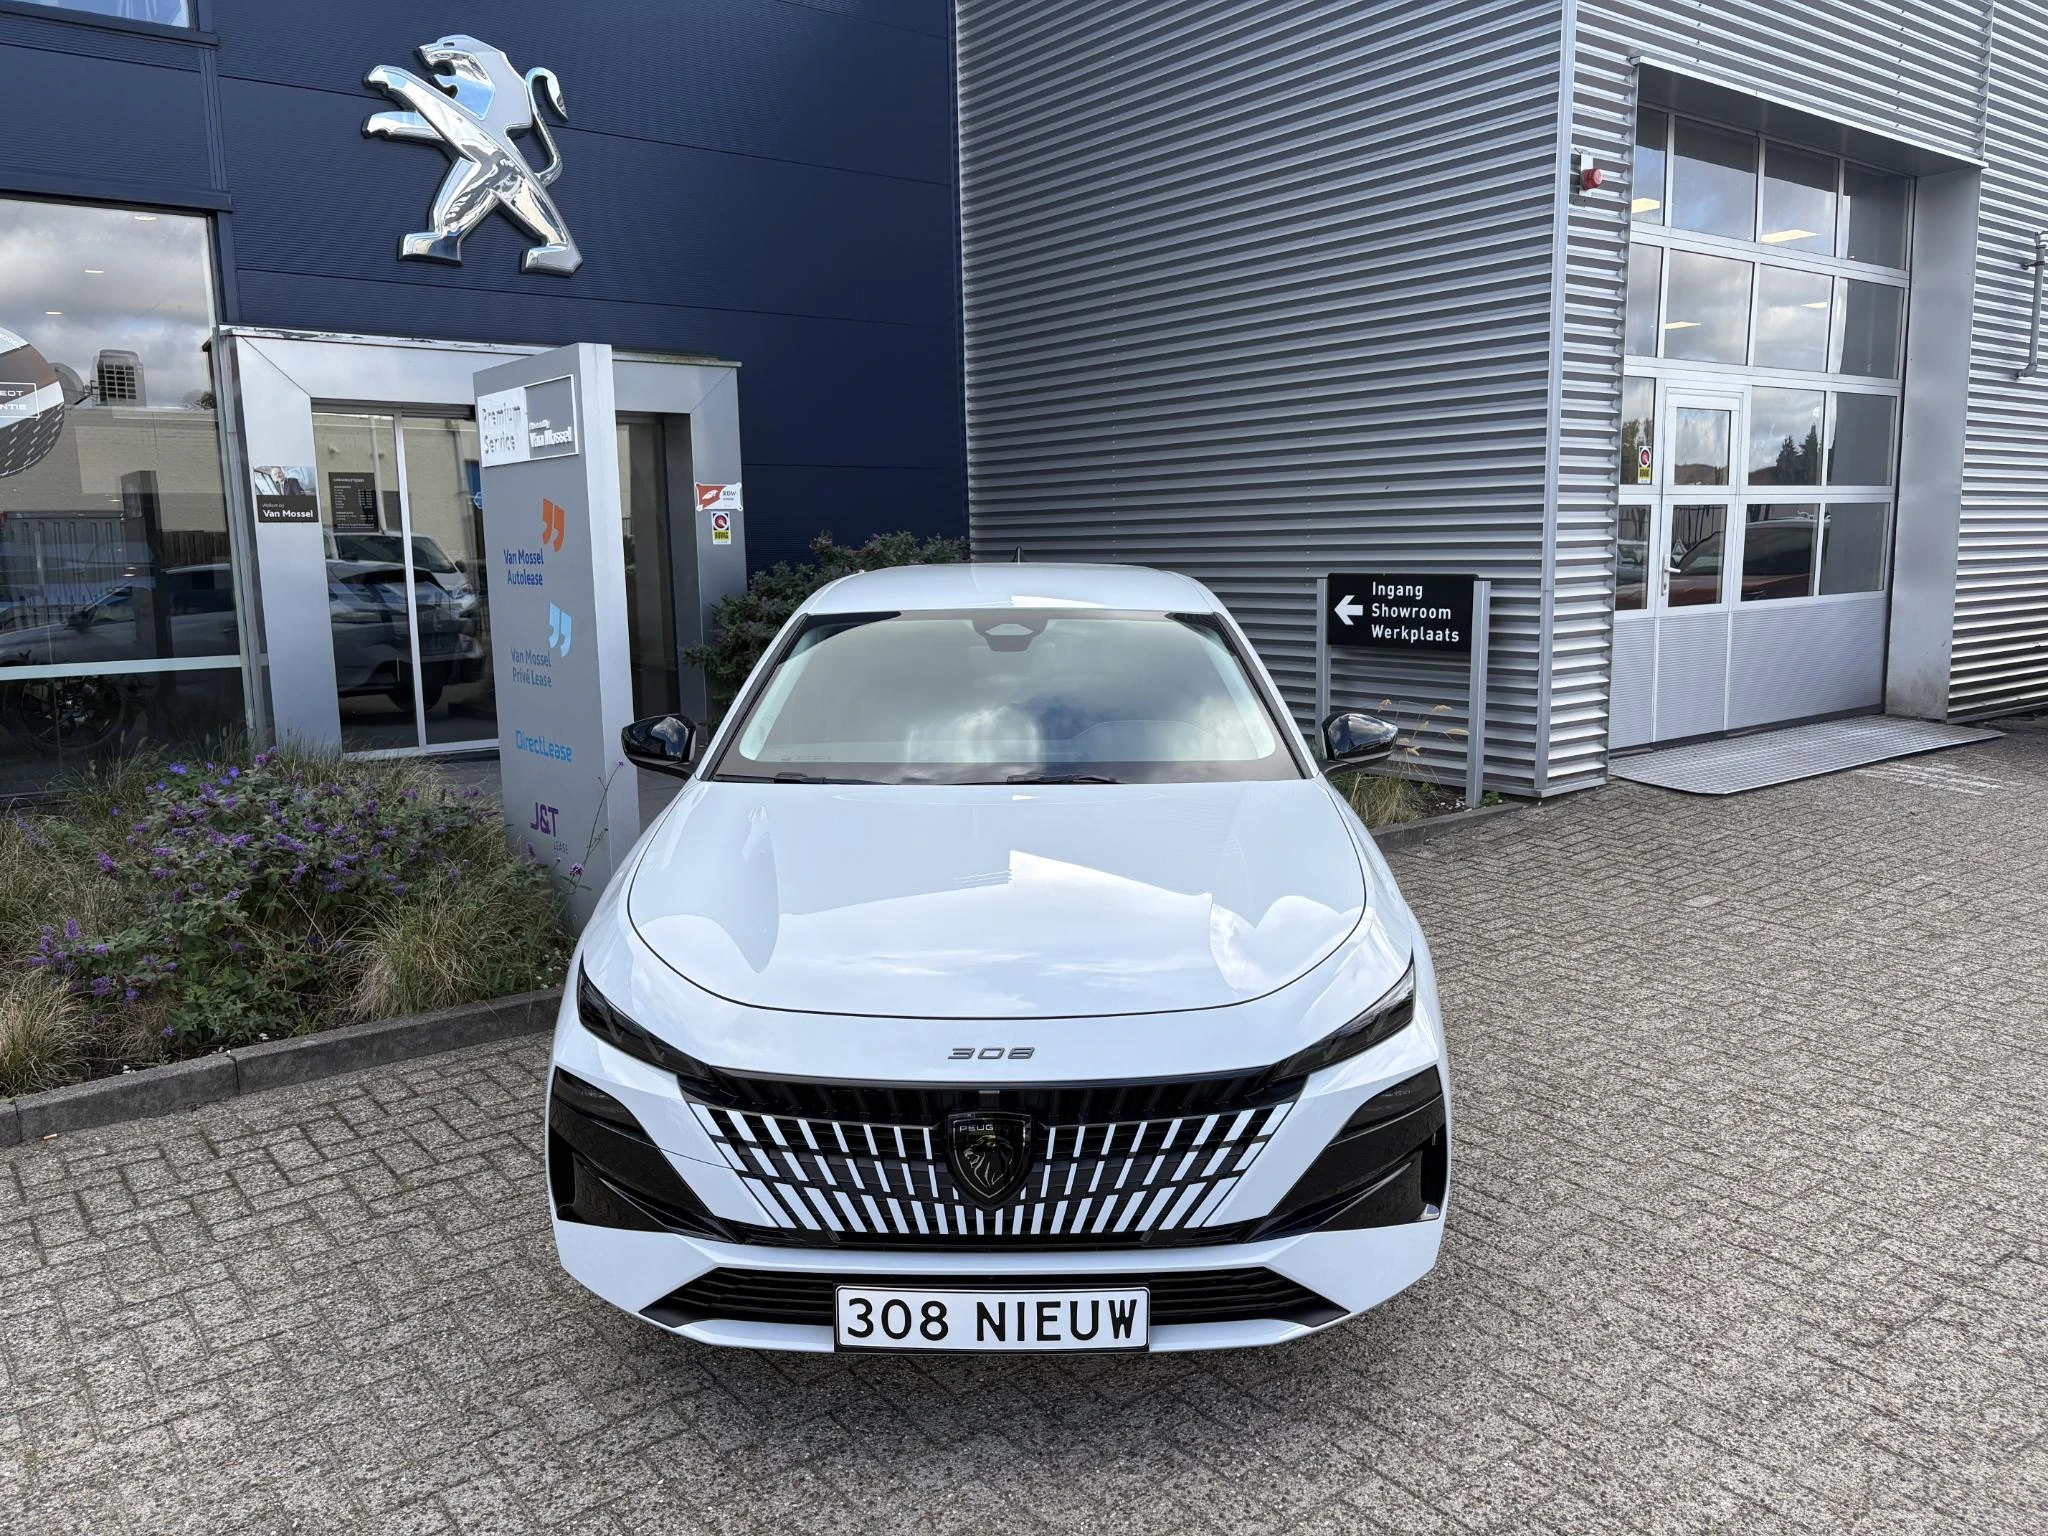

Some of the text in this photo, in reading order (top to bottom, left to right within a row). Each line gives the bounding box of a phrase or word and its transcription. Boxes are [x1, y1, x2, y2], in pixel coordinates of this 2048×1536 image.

[482, 402, 521, 425] Premium
[484, 431, 516, 454] Service
[530, 426, 572, 447] Van Mossel
[263, 510, 313, 518] Van Mossel
[504, 547, 544, 565] Van Mossel
[507, 569, 543, 586] Autolease
[1372, 581, 1423, 600] Ingang
[1371, 603, 1452, 620] Showroom
[1371, 624, 1460, 644] Werkplaats
[511, 648, 551, 667] Van Mossel
[512, 667, 552, 688] Privé Lease
[515, 730, 573, 762] DirectLease
[530, 802, 559, 837] J&T
[947, 1047, 1035, 1060] 308
[959, 1123, 1016, 1132] PEUG
[847, 1297, 1138, 1343] 308 NIEUW
